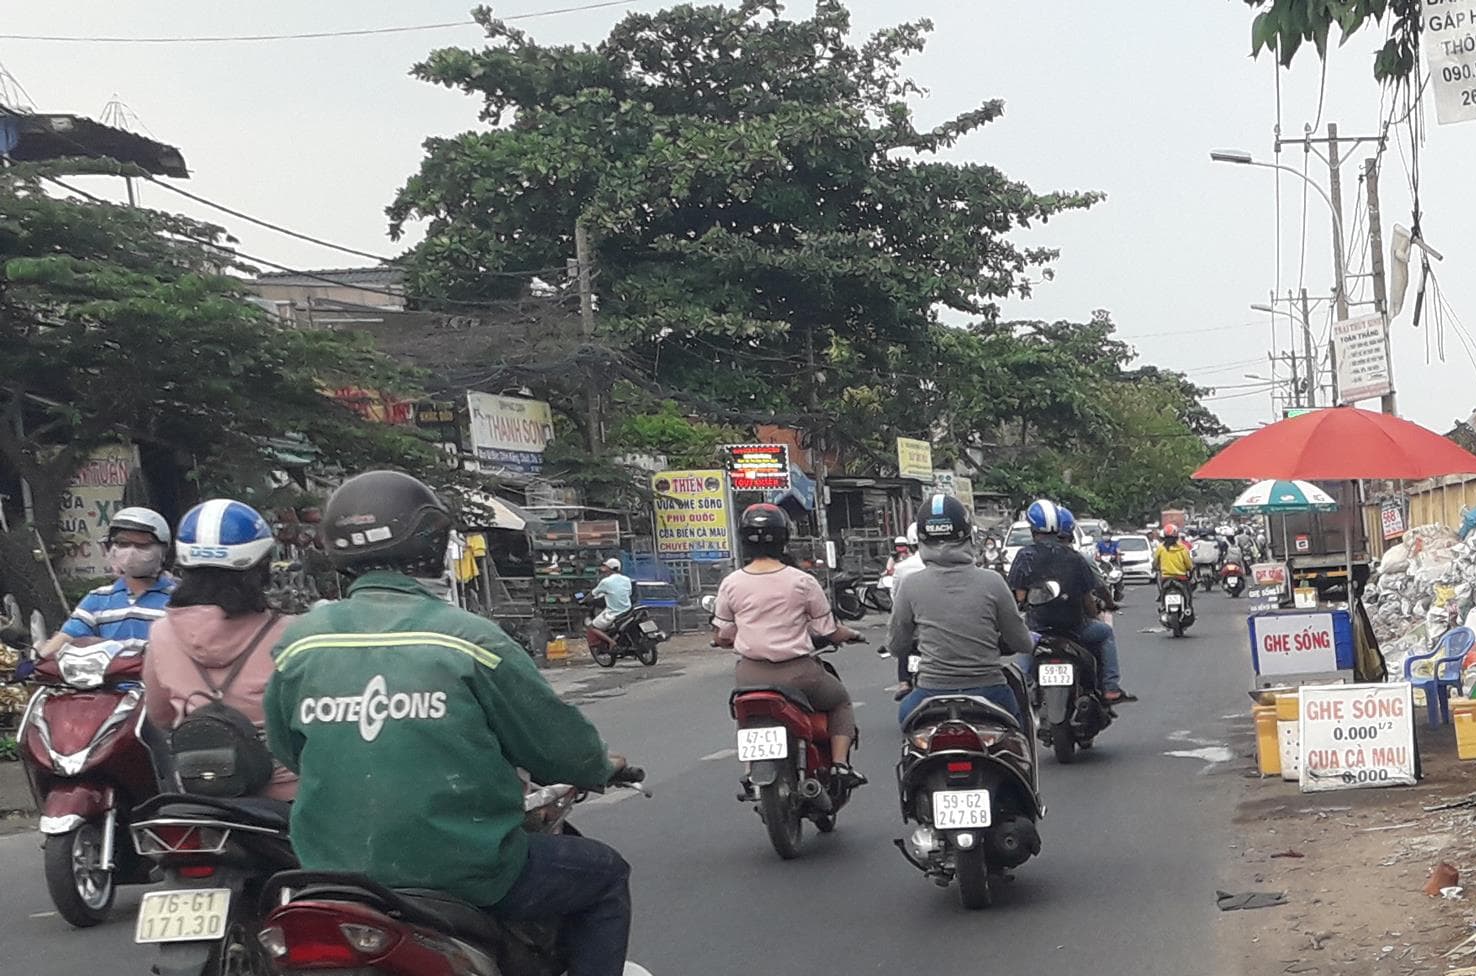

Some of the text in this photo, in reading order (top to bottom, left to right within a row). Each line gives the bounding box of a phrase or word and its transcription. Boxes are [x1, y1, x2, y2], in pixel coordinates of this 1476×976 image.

[1264, 625, 1331, 655] GHẸ SỐNG
[1306, 688, 1404, 723] GHẸ SỐNG
[1333, 726, 1378, 741] 0.000
[1308, 743, 1407, 770] CUA CÀ MAU
[939, 809, 988, 826] 247.68
[146, 914, 221, 938] 171.30
